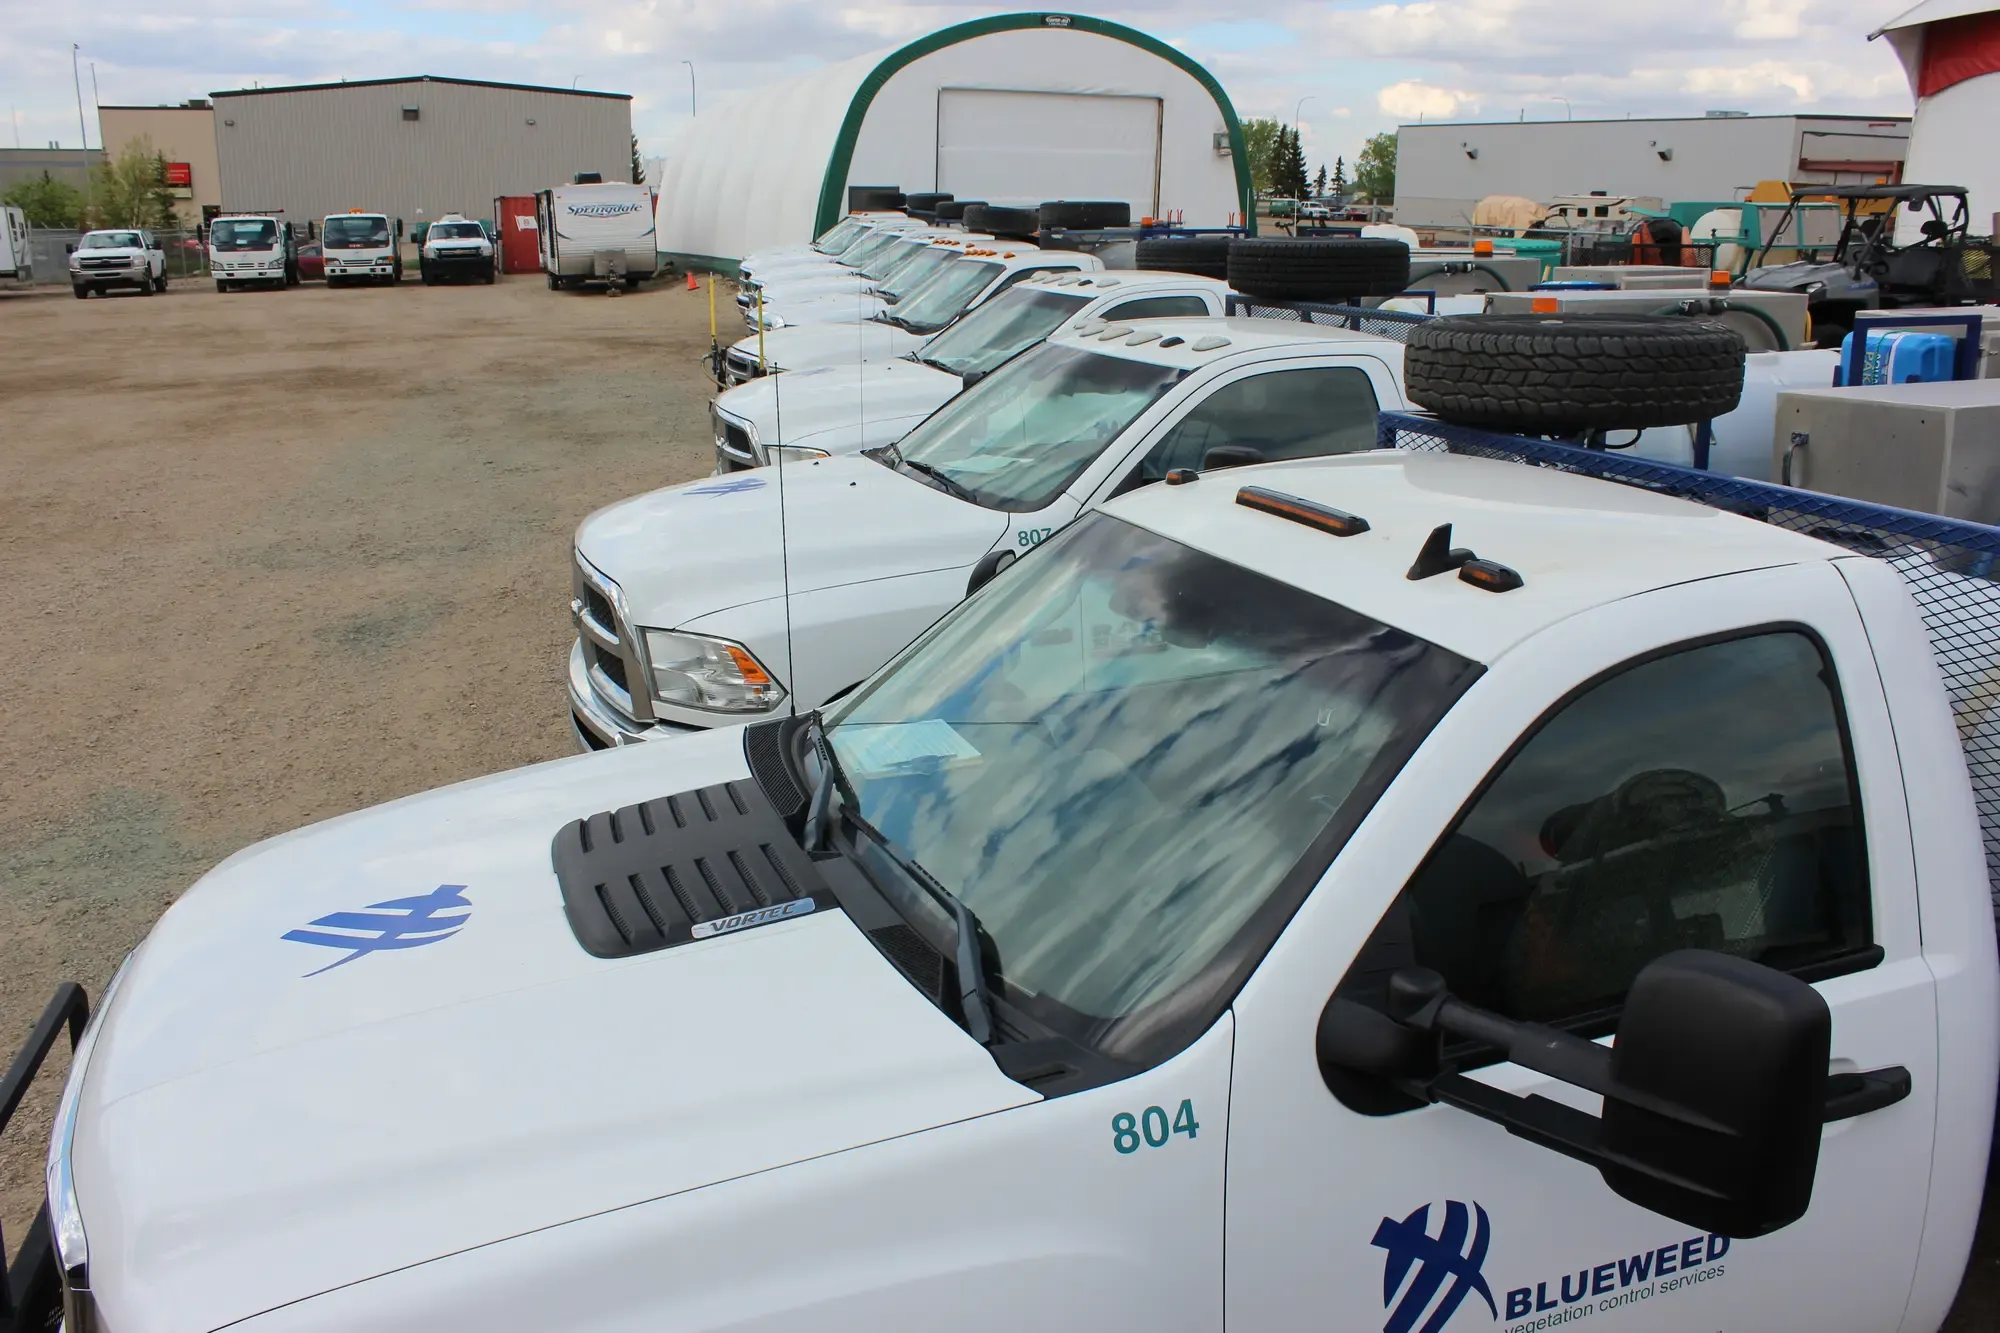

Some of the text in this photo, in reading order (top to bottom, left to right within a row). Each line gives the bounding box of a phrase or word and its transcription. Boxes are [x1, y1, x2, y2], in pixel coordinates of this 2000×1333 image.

[567, 203, 643, 217] Springdale
[1017, 527, 1052, 547] 807
[709, 902, 797, 932] VORTEC
[1111, 1098, 1200, 1154] 804
[1505, 1233, 1731, 1321] BLUEWEED
[1599, 1282, 1655, 1312] control
[1659, 1264, 1725, 1293] services
